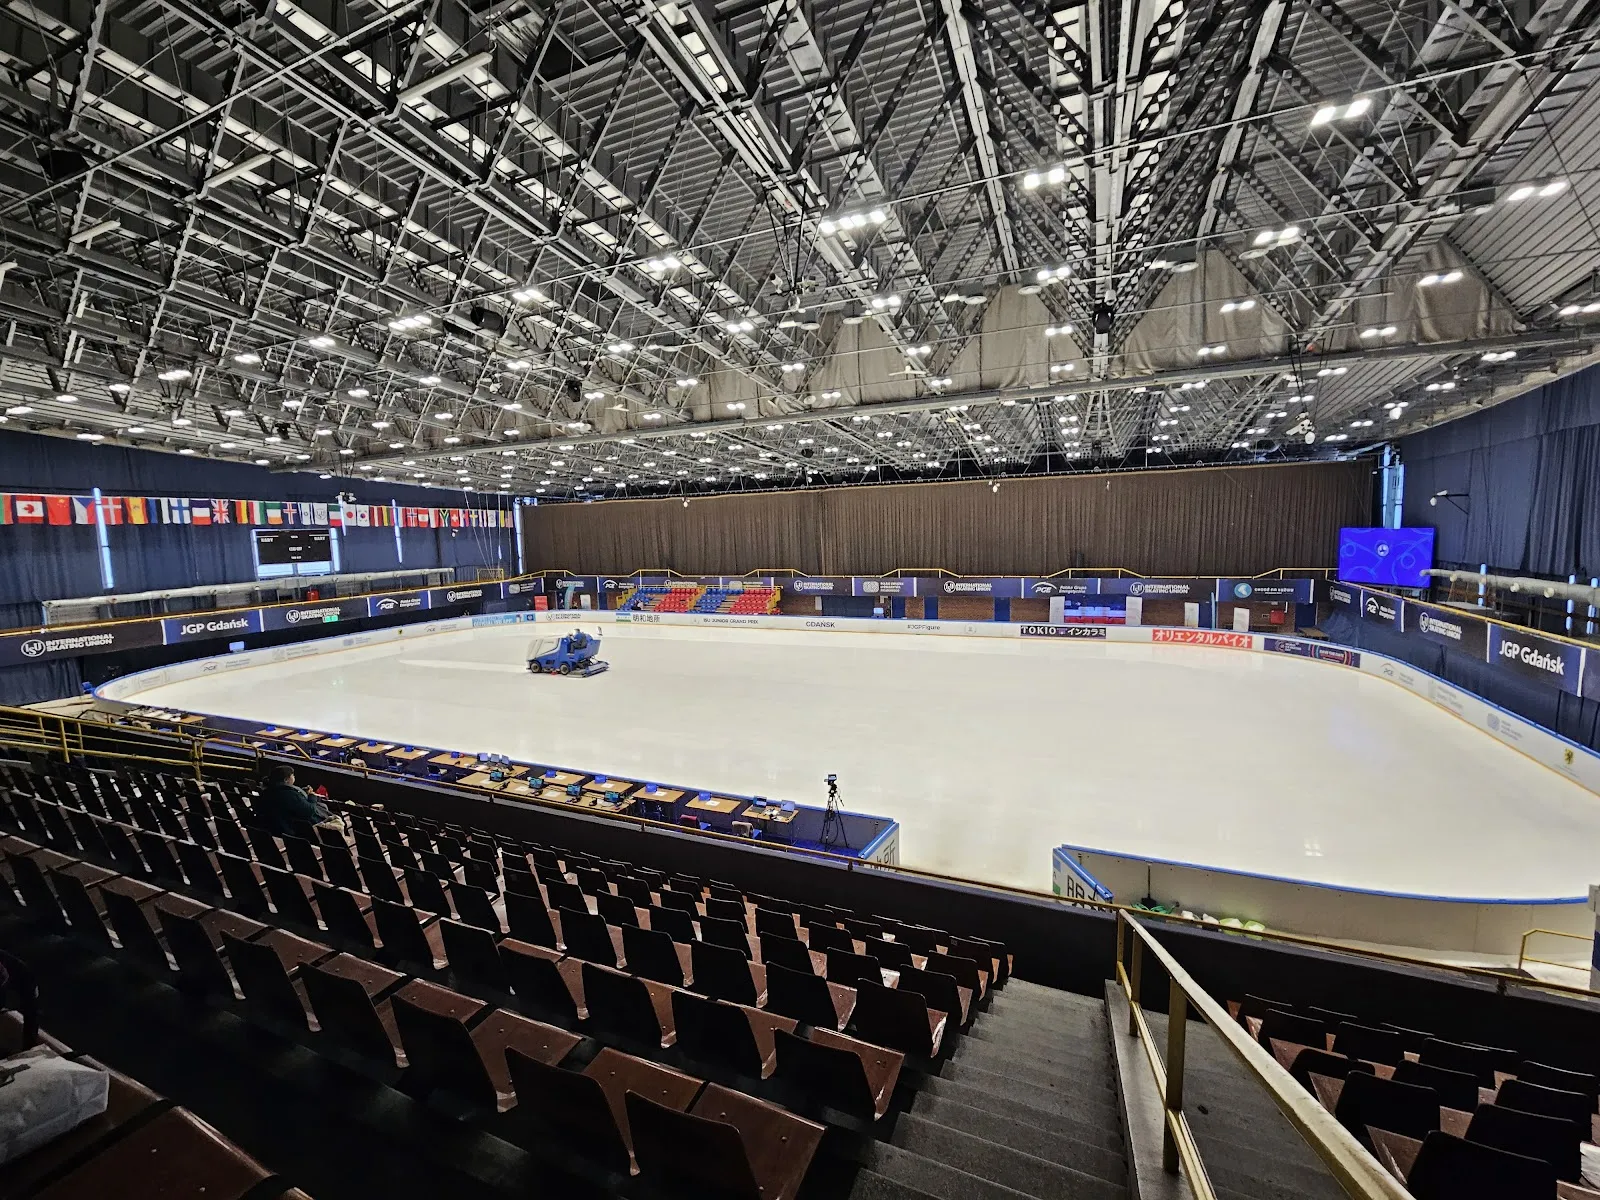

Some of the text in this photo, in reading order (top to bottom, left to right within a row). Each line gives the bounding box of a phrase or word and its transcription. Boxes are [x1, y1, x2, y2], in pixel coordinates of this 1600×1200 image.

[1132, 584, 1143, 595] ISU
[380, 602, 394, 610] PGE
[633, 615, 660, 623] 明和地所
[806, 620, 836, 628] GDAŃSK
[180, 617, 249, 636] JGP Gdańsk
[1021, 626, 1106, 636] TOKIO インカラミ
[45, 633, 114, 647] INTERNATIONAL
[46, 639, 113, 652] SKATING UNION
[1154, 630, 1251, 648] オリエンタルバイオ
[24, 642, 42, 655] ISU
[1499, 639, 1565, 676] JGP Gdańsk
